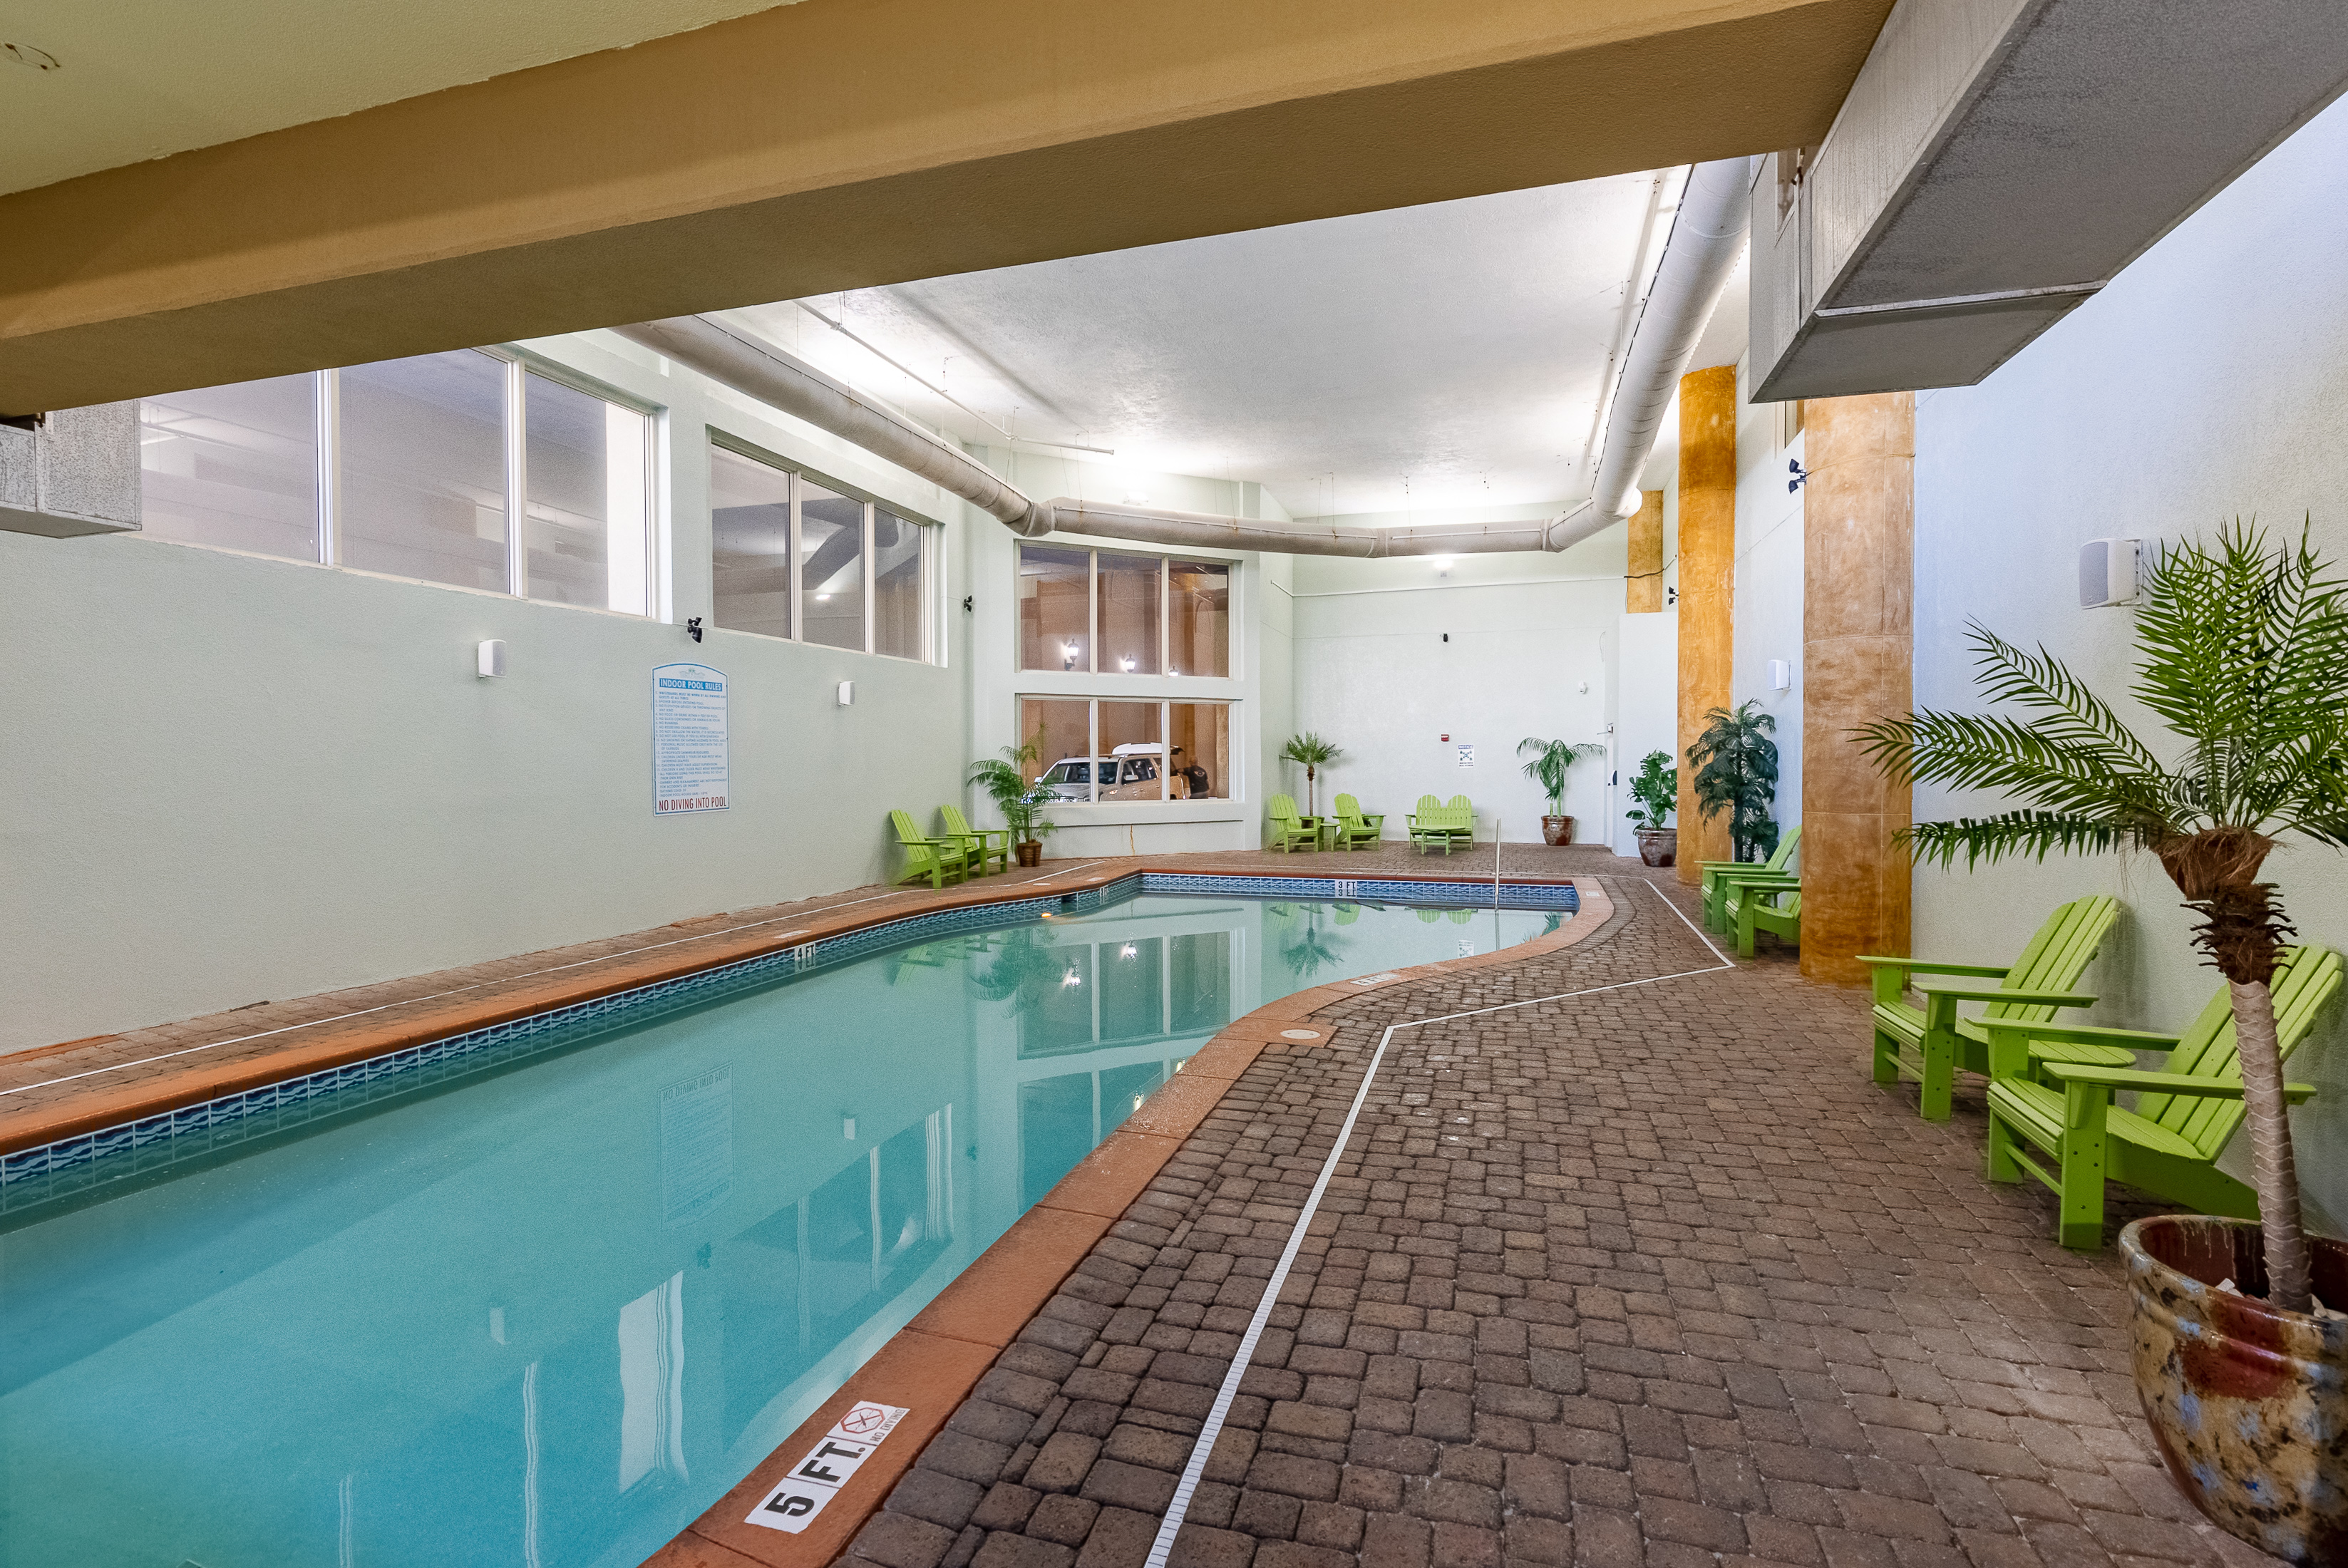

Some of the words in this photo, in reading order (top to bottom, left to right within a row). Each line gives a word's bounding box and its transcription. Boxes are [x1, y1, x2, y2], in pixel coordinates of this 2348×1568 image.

[660, 679, 686, 688] INDOOR
[659, 800, 669, 811] NO
[671, 798, 694, 810] DIVING
[696, 797, 709, 808] INTO
[711, 796, 726, 807] POOL
[798, 948, 802, 959] 4
[870, 1432, 885, 1442] NO
[880, 1408, 906, 1430] DIVING
[763, 1492, 815, 1517] 5
[798, 1441, 865, 1482] FT.
